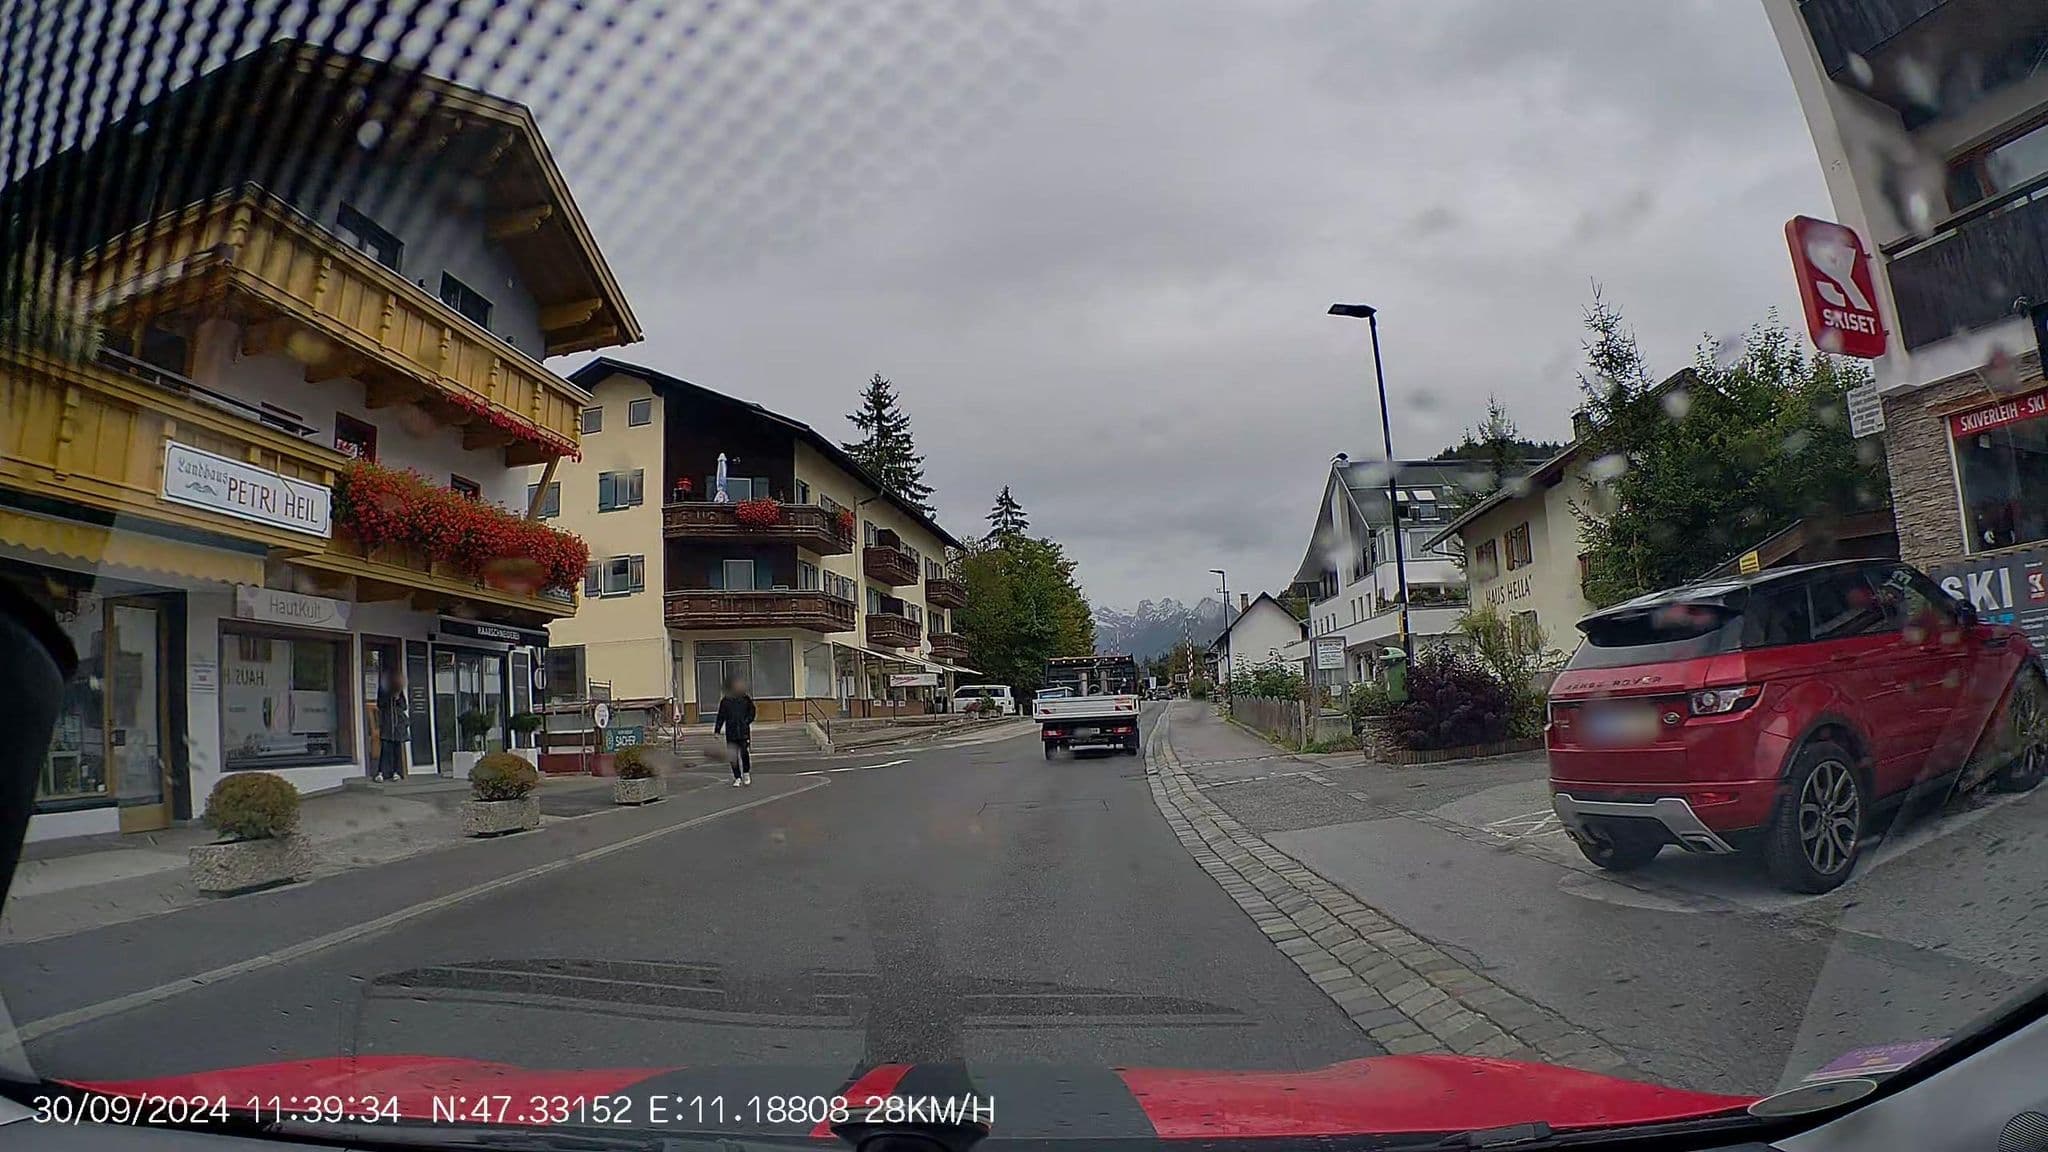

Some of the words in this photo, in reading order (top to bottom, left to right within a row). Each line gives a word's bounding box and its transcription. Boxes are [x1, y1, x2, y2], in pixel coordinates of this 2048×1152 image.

[1822, 307, 1876, 336] SKISET
[1960, 401, 2019, 431] SKIVERLEIH
[177, 456, 228, 484] Landhaus
[227, 477, 277, 514] PETRI
[284, 493, 318, 524] HEIL
[1485, 585, 1505, 606] HAUS
[1941, 567, 2014, 612] SKI
[269, 597, 322, 620] HautKult
